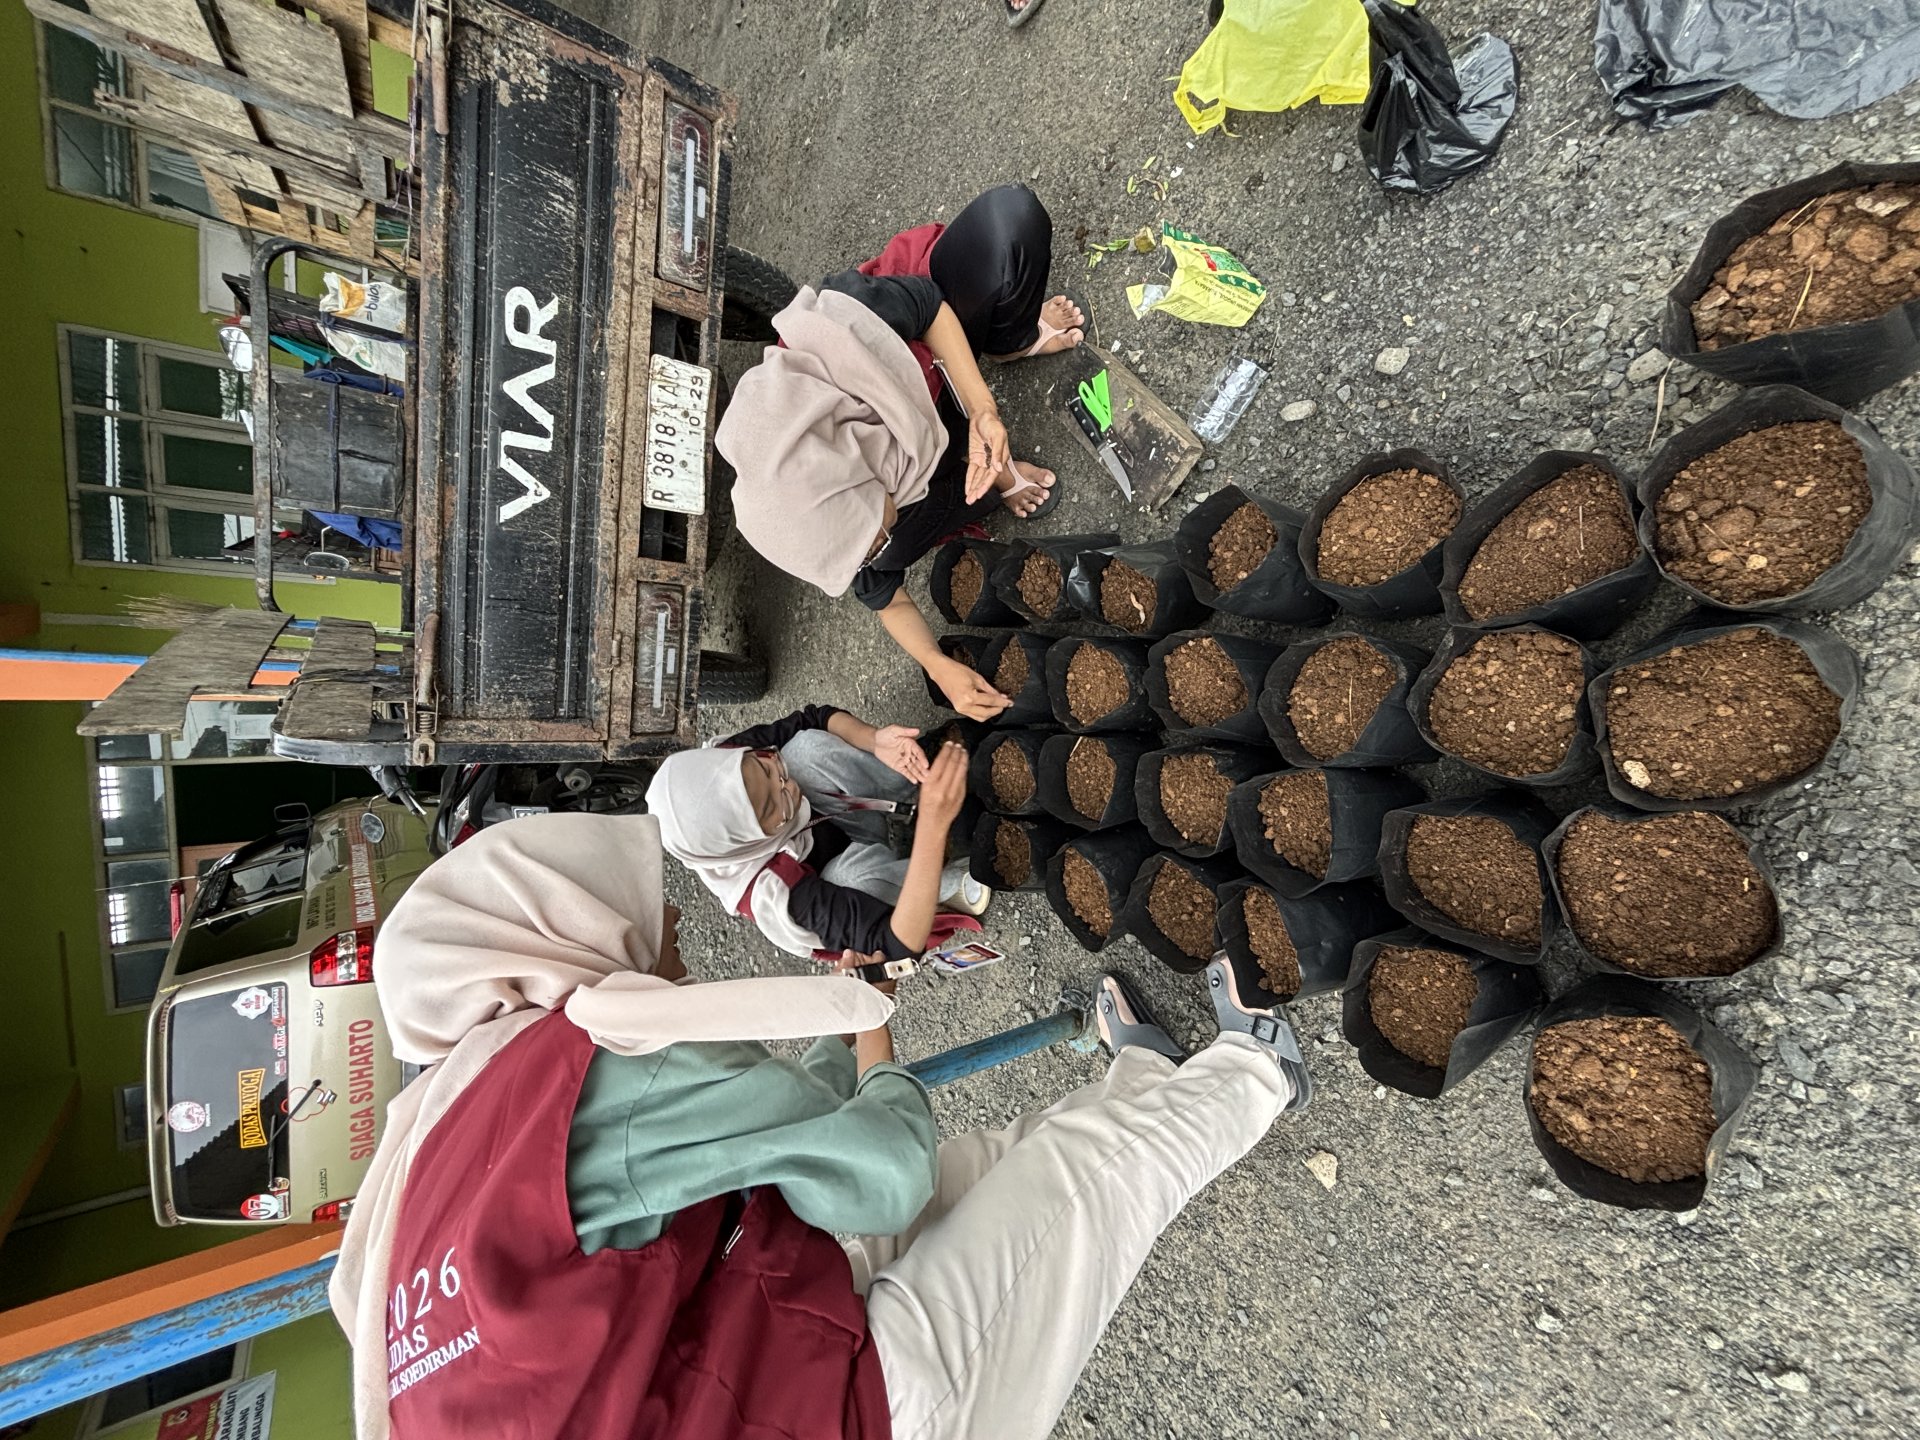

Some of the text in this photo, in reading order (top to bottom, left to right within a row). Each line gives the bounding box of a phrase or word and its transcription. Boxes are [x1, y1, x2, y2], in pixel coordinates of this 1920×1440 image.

[499, 286, 558, 523] VIAR
[653, 423, 676, 478] 3818
[652, 490, 675, 503] R
[275, 1025, 286, 1057] GARAGE
[241, 1071, 263, 1146] BODAS PRAYOGA
[348, 1019, 375, 1161] SIAGA SUHARTO
[247, 1199, 272, 1218] 07
[387, 1246, 461, 1340] 026
[398, 1325, 481, 1389] SOEDIRMAN
[220, 1390, 238, 1440] ARANGJATI
[236, 1407, 250, 1440] MBANG
